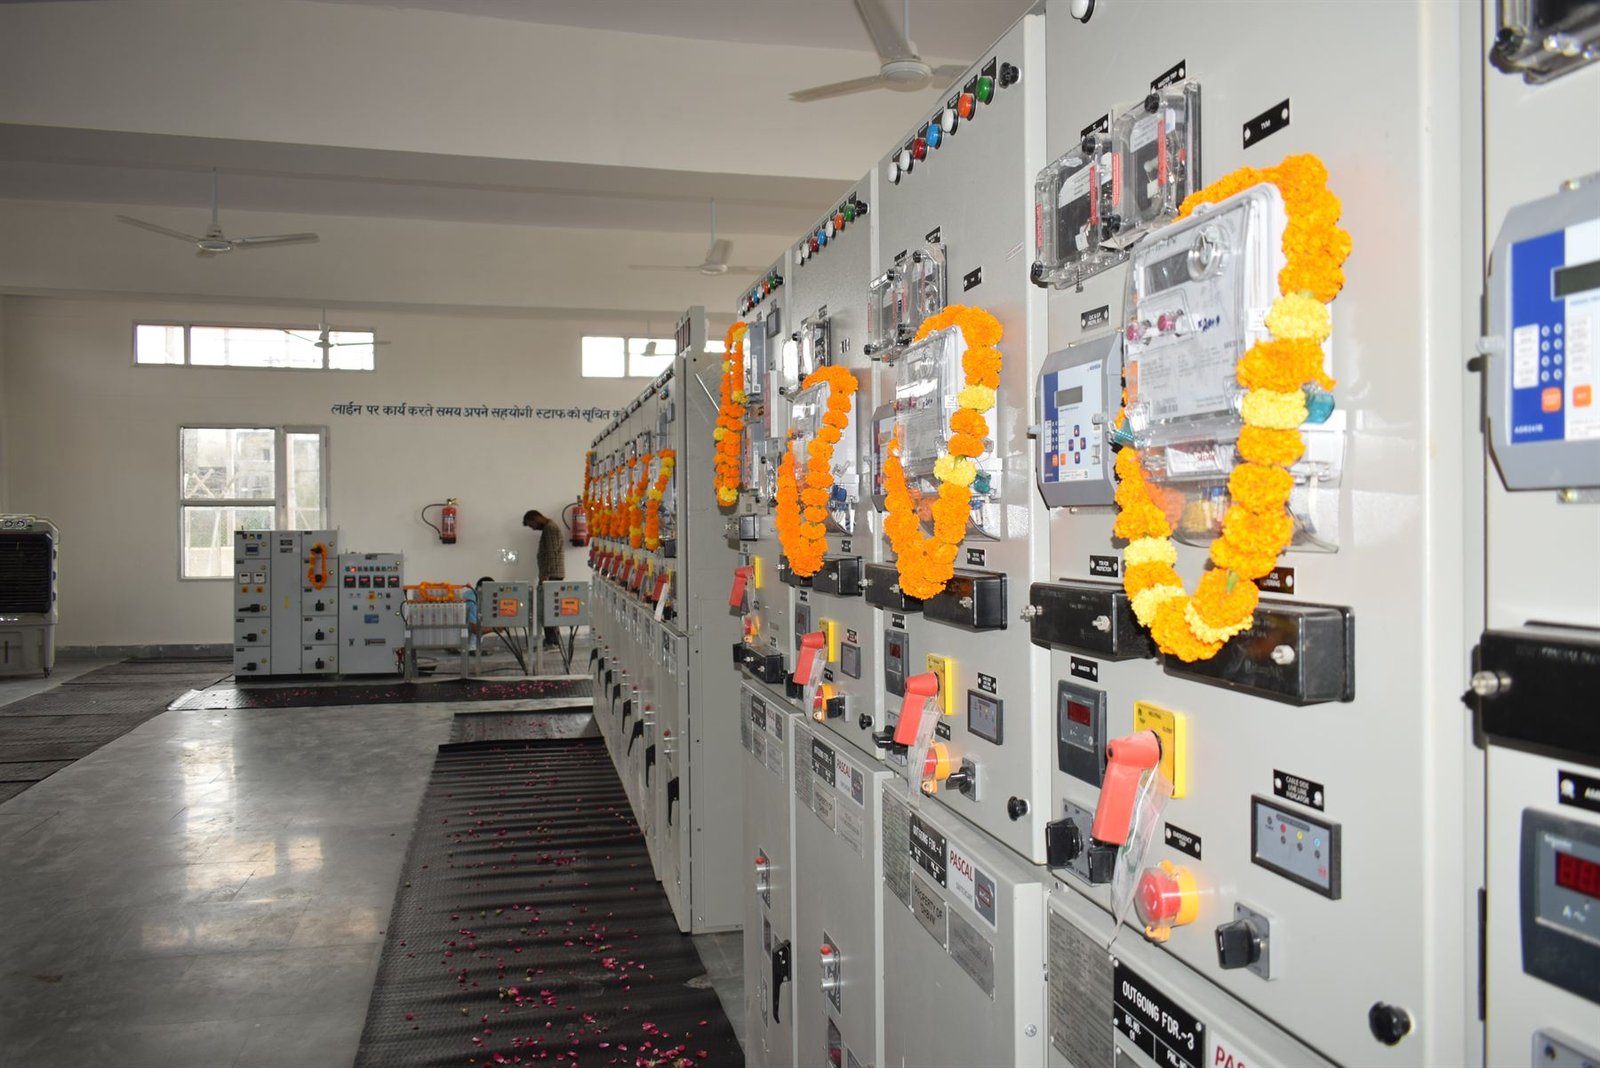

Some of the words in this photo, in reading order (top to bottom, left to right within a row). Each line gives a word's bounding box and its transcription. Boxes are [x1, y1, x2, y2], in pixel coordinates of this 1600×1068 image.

[365, 404, 379, 416] पर
[382, 402, 406, 416] कार्य
[408, 403, 433, 416] करते
[436, 406, 462, 417] समय
[463, 404, 488, 418] अपने
[491, 405, 532, 421] सहयोगी
[567, 406, 581, 419] को
[582, 406, 610, 422] सूचित
[949, 850, 973, 882] PASCAL
[1122, 980, 1160, 1022] OUTGOING
[1161, 1011, 1195, 1051] FDR.-3
